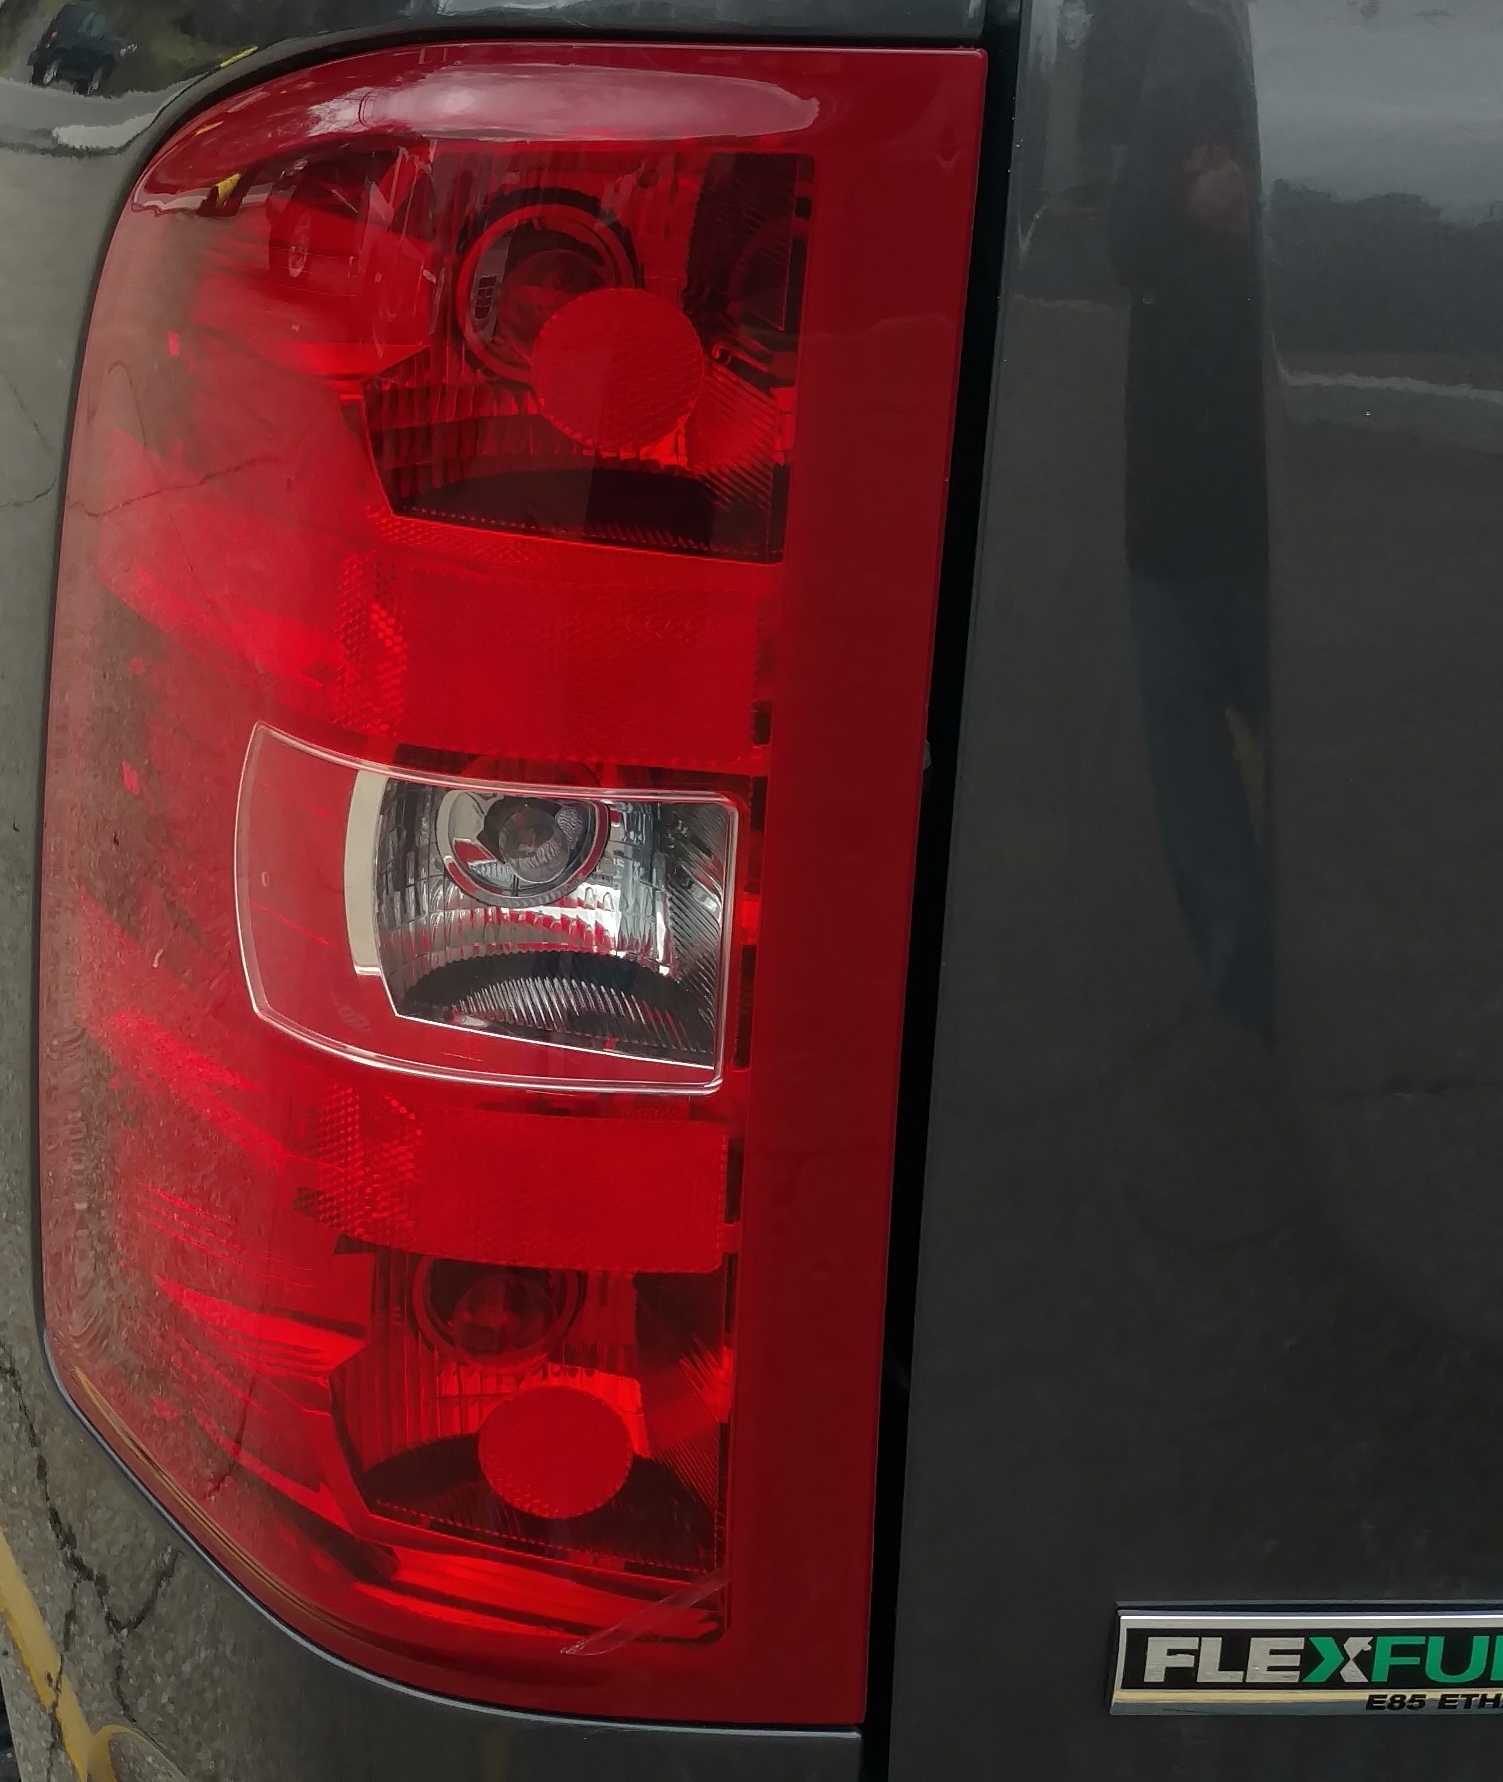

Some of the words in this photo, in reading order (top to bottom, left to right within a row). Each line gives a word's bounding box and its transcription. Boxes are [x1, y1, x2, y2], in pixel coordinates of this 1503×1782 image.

[1143, 1634, 1503, 1684] FLEXFU
[1365, 1693, 1427, 1711] E85
[1437, 1692, 1503, 1710] ETH
